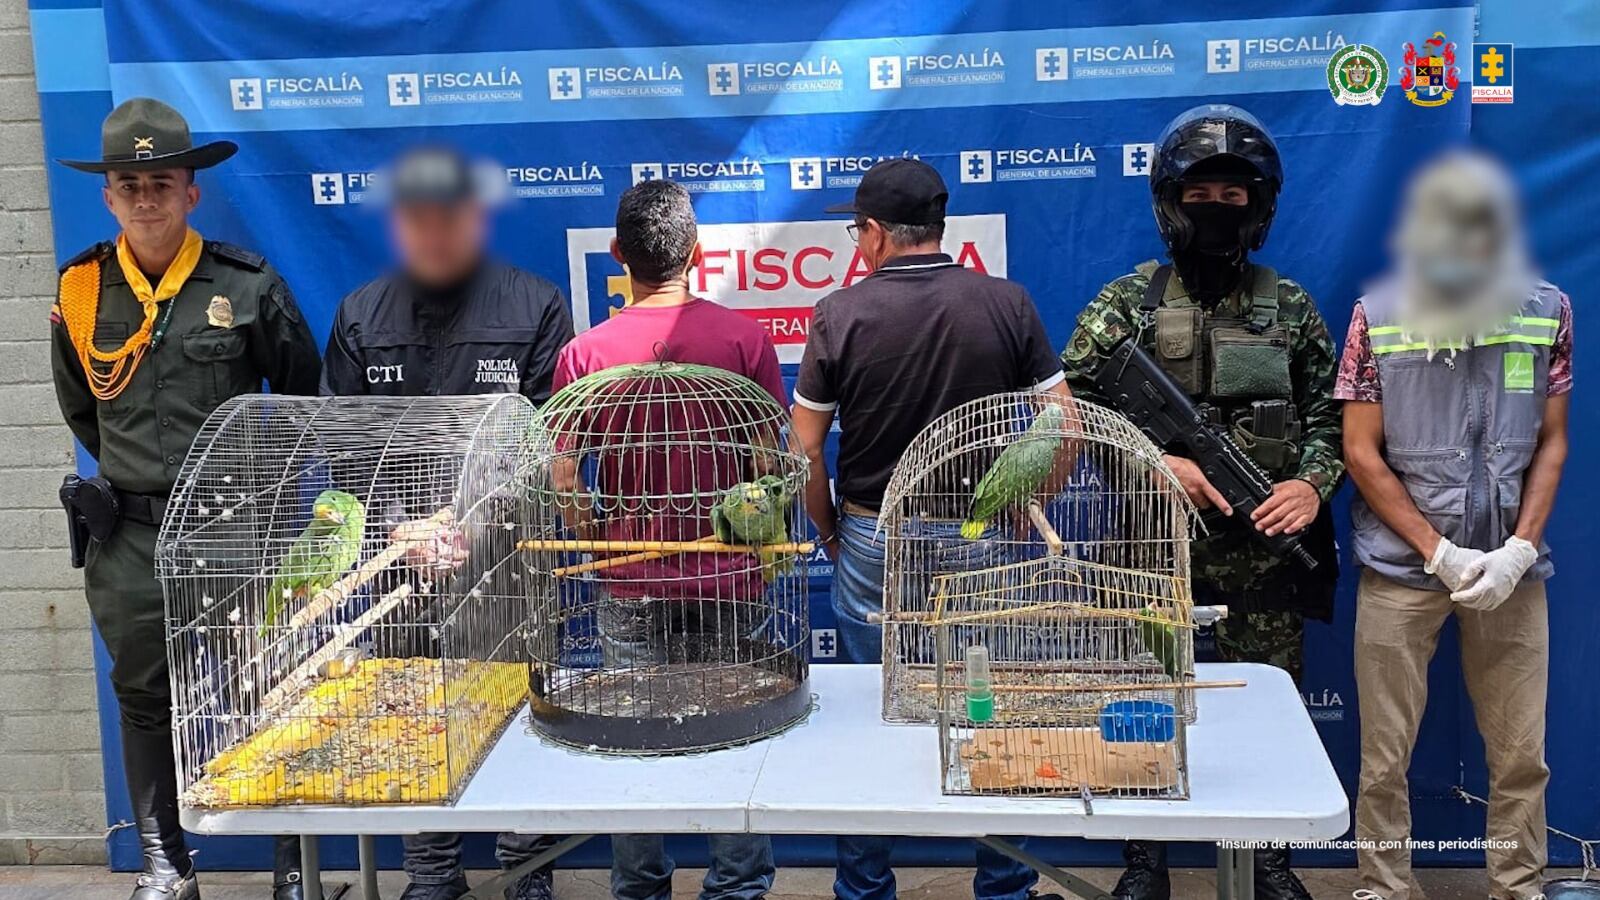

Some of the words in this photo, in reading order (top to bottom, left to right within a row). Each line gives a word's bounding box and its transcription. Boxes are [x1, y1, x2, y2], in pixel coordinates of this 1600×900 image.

[1073, 40, 1175, 63] FISCALÍA
[1245, 30, 1347, 55] FISCALÍA
[744, 56, 843, 78] FISCALÍA
[906, 48, 1005, 71] FISCALÍA
[1288, 59, 1299, 67] DE
[423, 66, 522, 88] FISCALÍA
[585, 61, 683, 82] FISCALÍA
[972, 72, 1003, 81] NACIÓN
[1115, 68, 1126, 76] DE
[266, 72, 363, 93] FISCALÍA
[628, 88, 638, 96] DE
[310, 98, 319, 106] DE
[467, 93, 476, 101] DE
[996, 143, 1096, 166] FISCALÍA
[506, 161, 603, 183] FISCALÍA
[667, 157, 764, 178] FISCALÍA
[1000, 171, 1037, 179] GENERAL
[1039, 170, 1049, 178] DE
[1051, 169, 1062, 177] LA
[1062, 168, 1094, 176] NACIÓN
[514, 187, 547, 196] ENERAL
[548, 187, 559, 195] DE
[572, 184, 601, 194] NACIÓN
[829, 177, 862, 186] GENERA
[697, 241, 989, 293] FISCAA
[366, 364, 405, 384] CTI
[476, 357, 518, 372] POLICÍA
[475, 371, 521, 384] JUDICIAL
